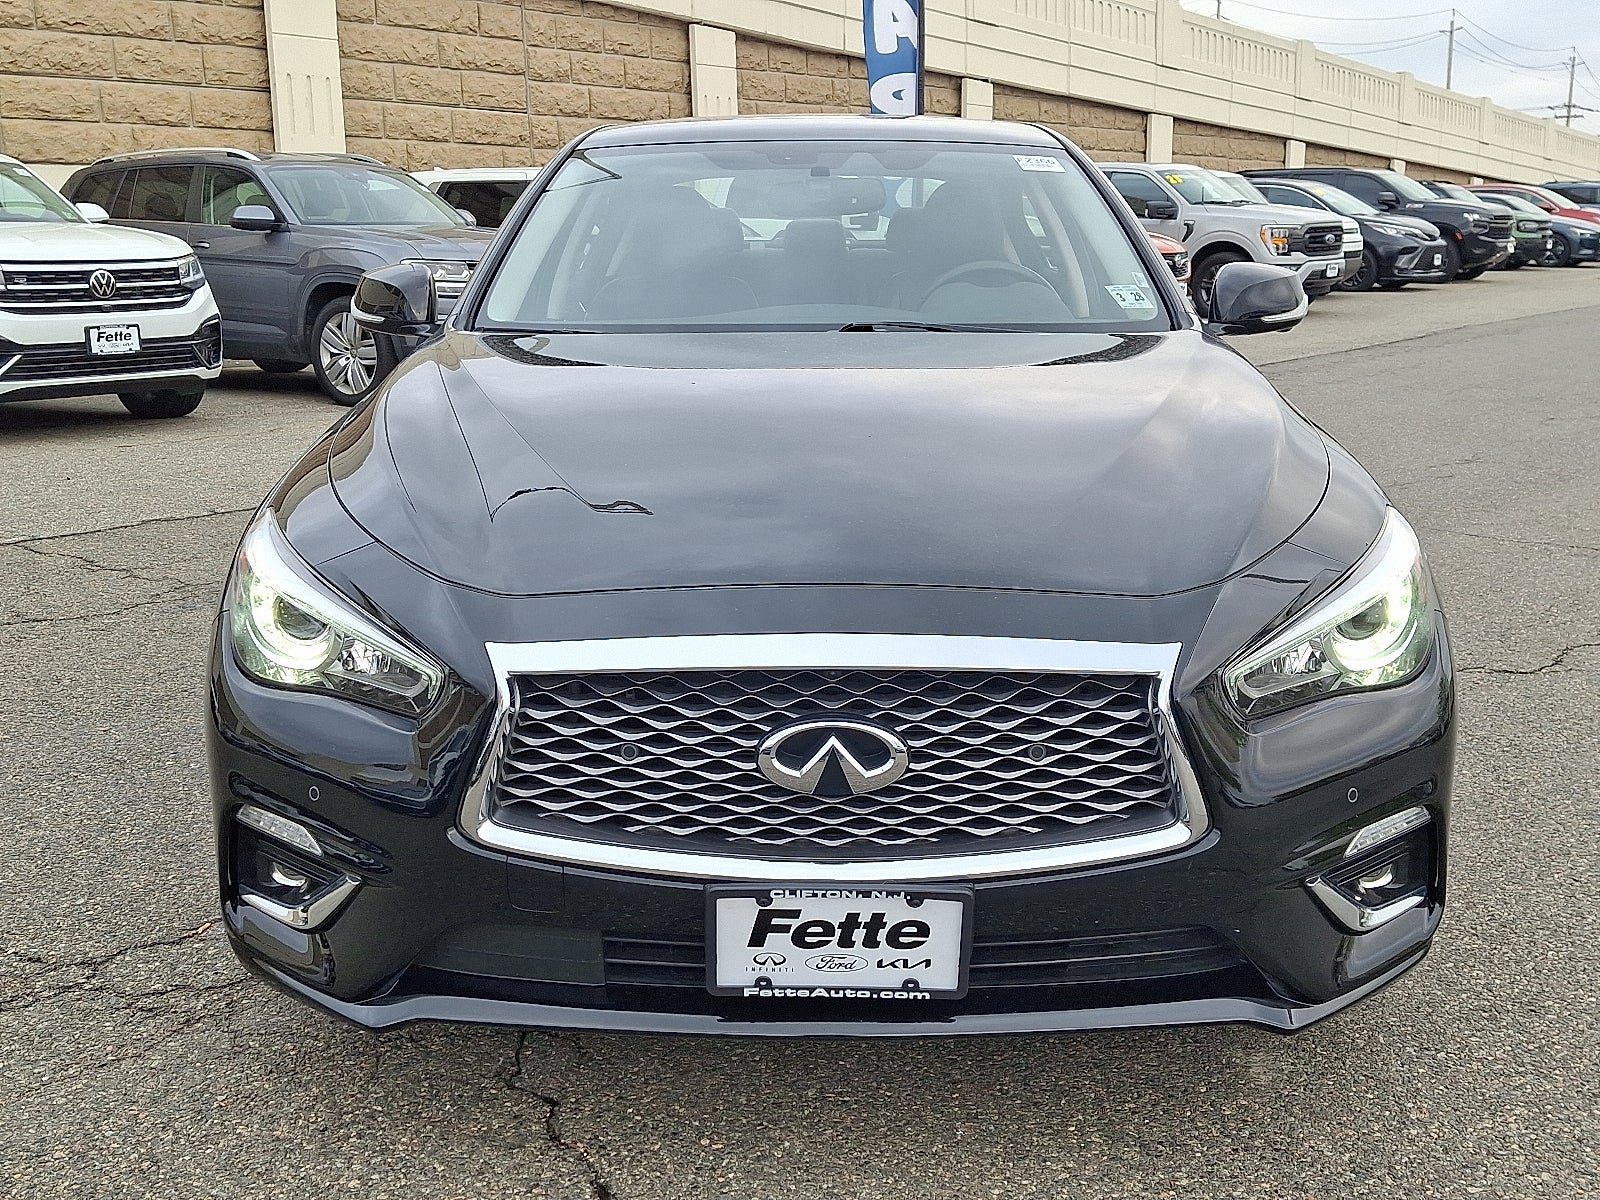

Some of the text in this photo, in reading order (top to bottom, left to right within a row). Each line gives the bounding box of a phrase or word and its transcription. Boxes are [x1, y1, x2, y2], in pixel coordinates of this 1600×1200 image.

[1115, 292, 1126, 302] 3
[1130, 291, 1145, 302] 28
[97, 331, 132, 342] Fette
[871, 890, 911, 900] N.J.
[747, 908, 931, 950] Fette
[876, 958, 932, 970] KIA
[743, 987, 931, 1000] FetteAuto.com
